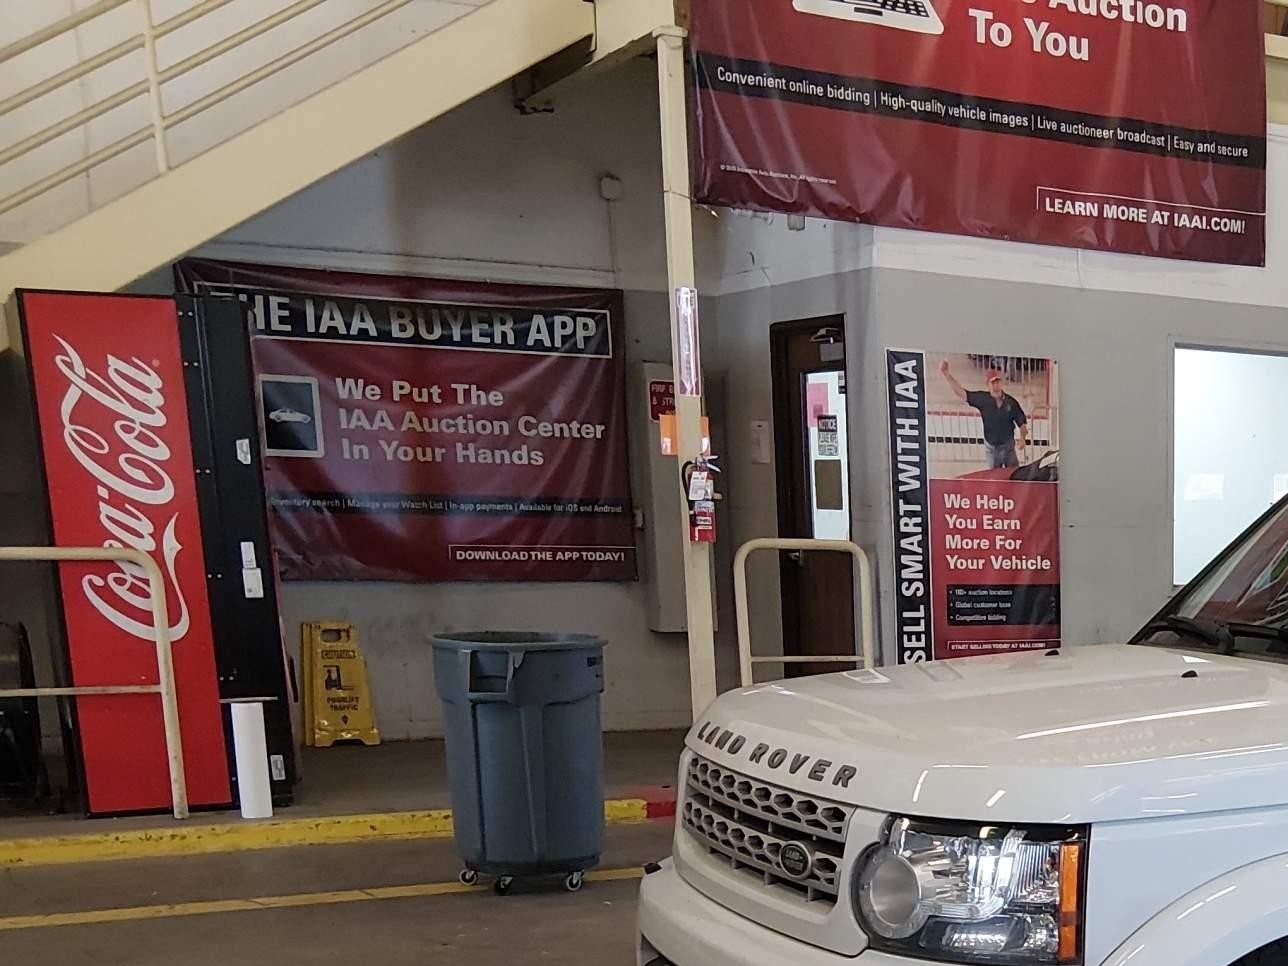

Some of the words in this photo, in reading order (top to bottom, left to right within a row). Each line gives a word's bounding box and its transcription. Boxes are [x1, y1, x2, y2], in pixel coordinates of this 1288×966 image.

[968, 8, 1012, 47] To
[1023, 17, 1089, 61] You
[718, 66, 786, 90] Convenient
[789, 80, 823, 97] online
[827, 84, 870, 106] bidding
[880, 93, 946, 117] High-quality
[948, 104, 986, 121] vehicle
[989, 110, 1028, 127] images
[1037, 116, 1057, 131] Live
[1060, 122, 1114, 139] auctioneer
[1117, 128, 1166, 147] broadcast
[1174, 136, 1194, 154] Easy
[1197, 141, 1215, 154] and
[1217, 144, 1248, 157] secure
[1046, 197, 1099, 217] LEARN
[1103, 203, 1147, 223] MORE
[1151, 210, 1170, 225] AT
[1174, 213, 1246, 234] IAAI.COM!
[304, 299, 378, 337] IAA
[388, 305, 515, 345] BUYER
[526, 314, 597, 349] APP
[335, 377, 381, 401] We
[392, 380, 442, 404] Put
[451, 383, 504, 407] The
[895, 360, 919, 408] IAA
[338, 408, 395, 432] IAA
[401, 410, 510, 435] Auction
[517, 415, 605, 440] Center
[341, 438, 369, 460] In
[379, 440, 445, 462] Your
[456, 442, 544, 466] Hands
[896, 418, 922, 493] WITH
[401, 500, 427, 509] Watch
[476, 503, 513, 512] payments
[944, 493, 970, 509] We
[976, 494, 1014, 512] Help
[945, 514, 977, 529] You
[983, 515, 1021, 530] Earn
[456, 550, 528, 561] DOWNLOAD
[530, 551, 553, 561] THE
[556, 551, 579, 561] APP
[581, 551, 625, 561] TODAY!
[899, 499, 925, 597] SMART
[945, 534, 990, 549] More
[995, 535, 1022, 550] For
[945, 554, 985, 569] Your
[990, 555, 1051, 570] Vehicle
[903, 605, 926, 664] SELL
[697, 721, 746, 754] LAND
[749, 743, 857, 788] ROVER
